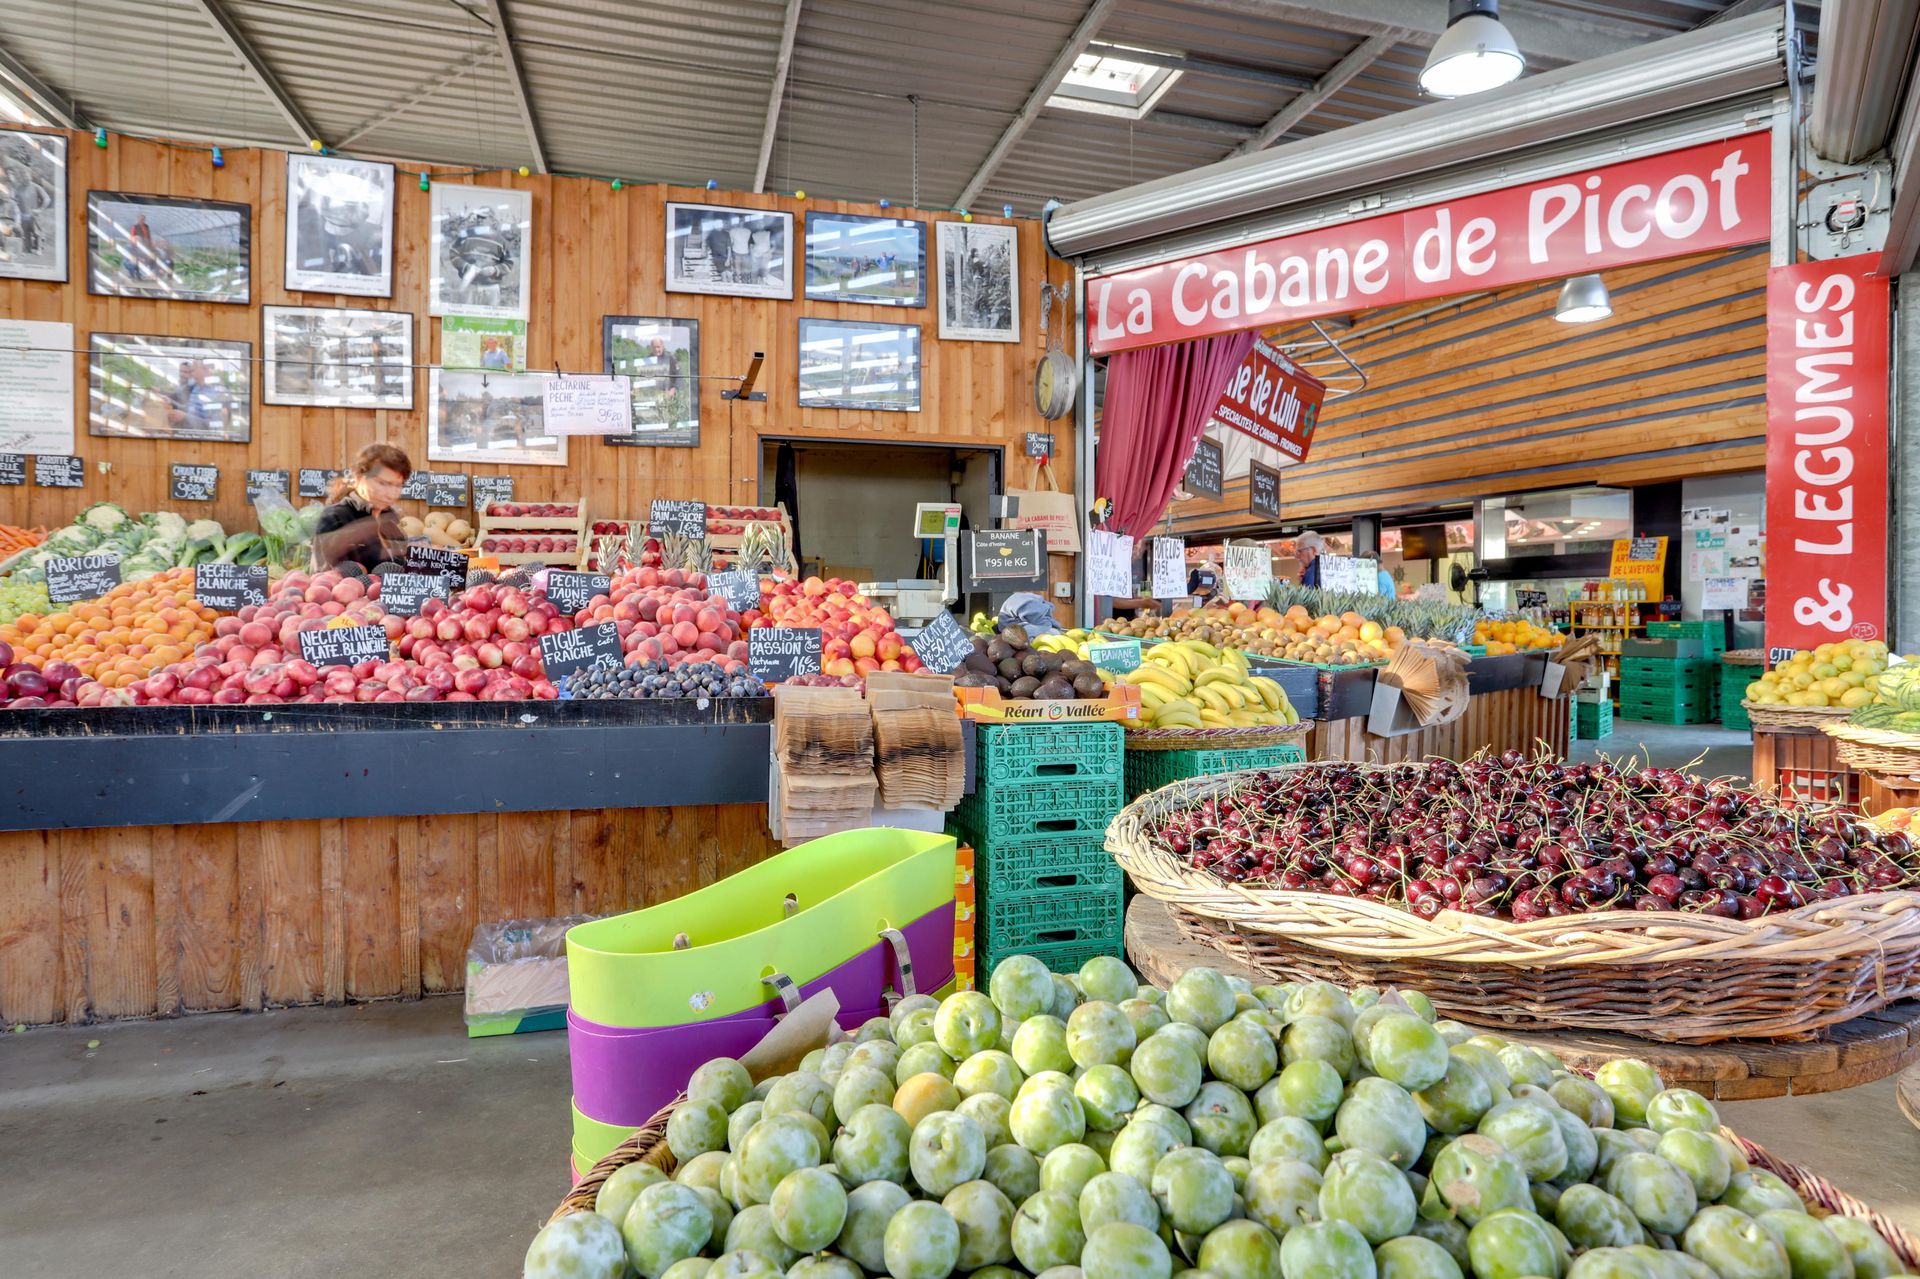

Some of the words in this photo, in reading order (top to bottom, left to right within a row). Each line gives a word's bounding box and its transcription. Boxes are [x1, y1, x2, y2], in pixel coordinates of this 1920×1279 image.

[1098, 281, 1152, 341] La
[1172, 239, 1389, 327] Cabane
[1413, 208, 1497, 283] de
[1528, 150, 1749, 264] Picot
[549, 381, 591, 391] NECTARINE
[549, 392, 574, 403] PECHE
[1250, 365, 1271, 416] de
[1268, 377, 1301, 433] Lulu
[1794, 273, 1855, 554] LEGUMES
[651, 500, 690, 513] ANANAS
[651, 511, 670, 521] PAIN
[990, 532, 1020, 540] BANANE
[1003, 557, 1013, 567] le
[1014, 557, 1028, 567] KG
[1226, 547, 1258, 567] ANANAS
[196, 563, 237, 578] PECHE
[706, 567, 757, 588] NECTARINE
[196, 577, 249, 590] BLANCHE
[383, 573, 443, 589] NECTARINE
[195, 593, 237, 608] FRANCE
[380, 594, 416, 606] FRANCE
[548, 586, 589, 600] JAUNE
[1794, 577, 1853, 632] &
[300, 626, 371, 647] NECTARINE
[541, 628, 586, 654] FIGUE
[750, 627, 795, 642] FRUITS
[1004, 705, 1044, 718] Réart
[1066, 703, 1106, 717] Vallée
